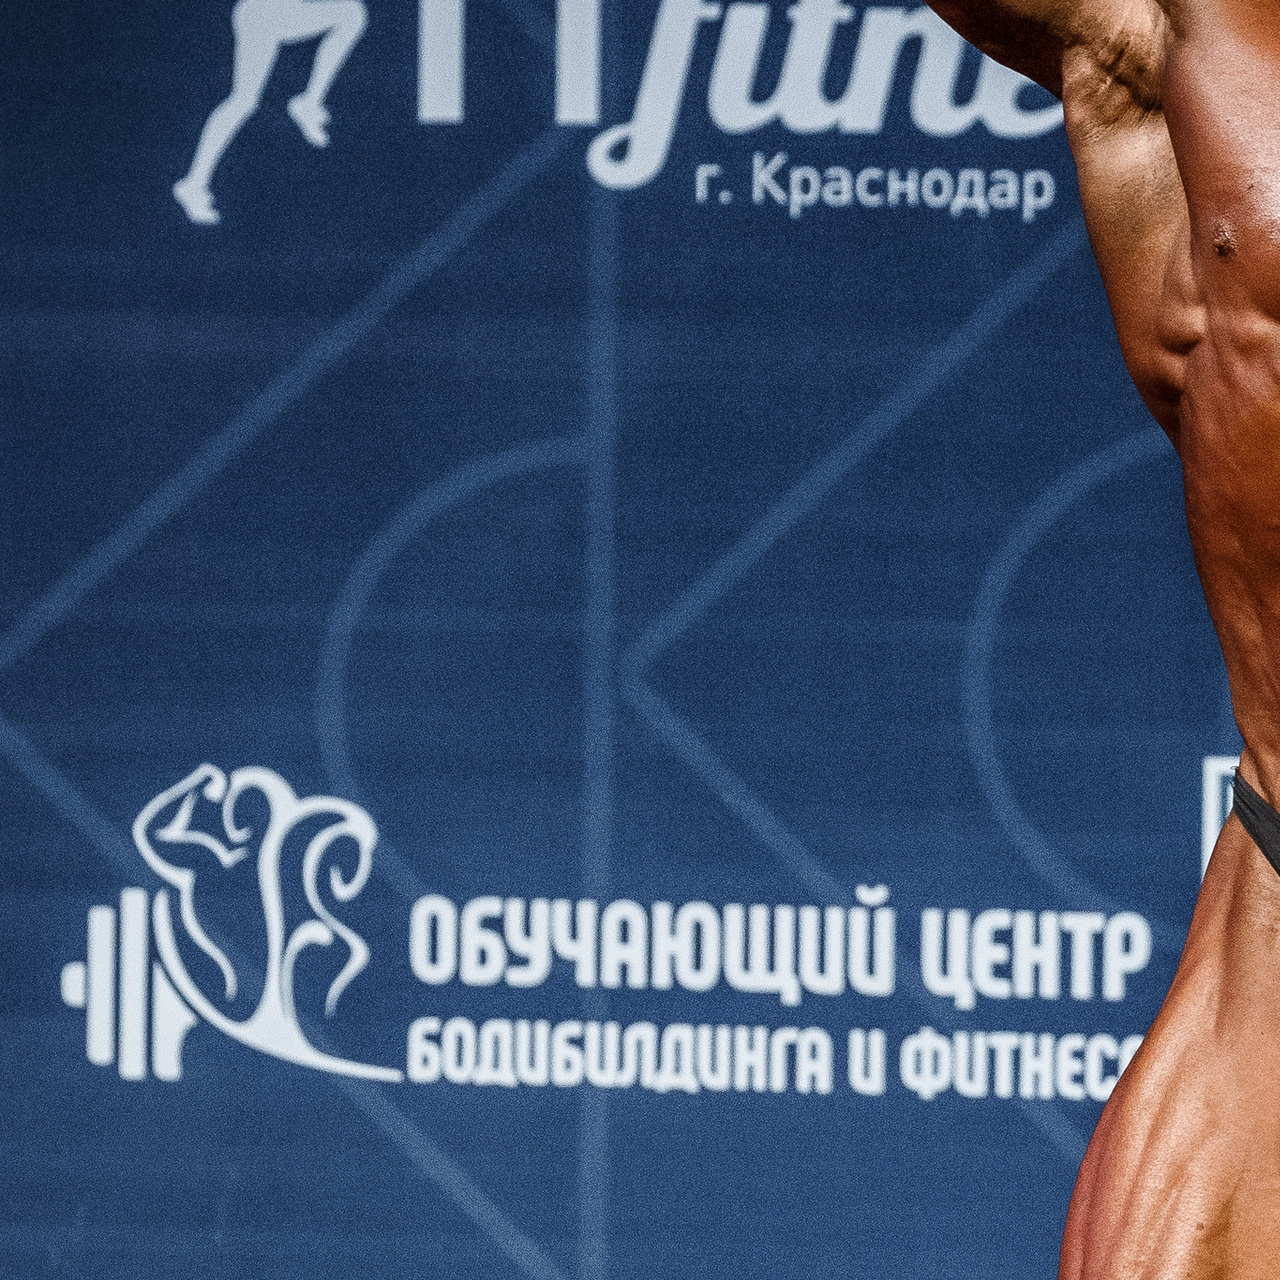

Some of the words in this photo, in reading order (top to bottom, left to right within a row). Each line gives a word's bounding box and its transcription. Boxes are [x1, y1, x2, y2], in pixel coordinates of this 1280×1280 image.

[694, 162, 733, 204] г.
[751, 151, 1056, 222] Краснодар
[408, 883, 897, 1007] ОБУЧАЮЩИЙ
[919, 906, 1153, 1011] ЦЕНТР
[405, 1015, 835, 1097] БОДИБИЛДИНГА
[847, 1027, 888, 1097] И
